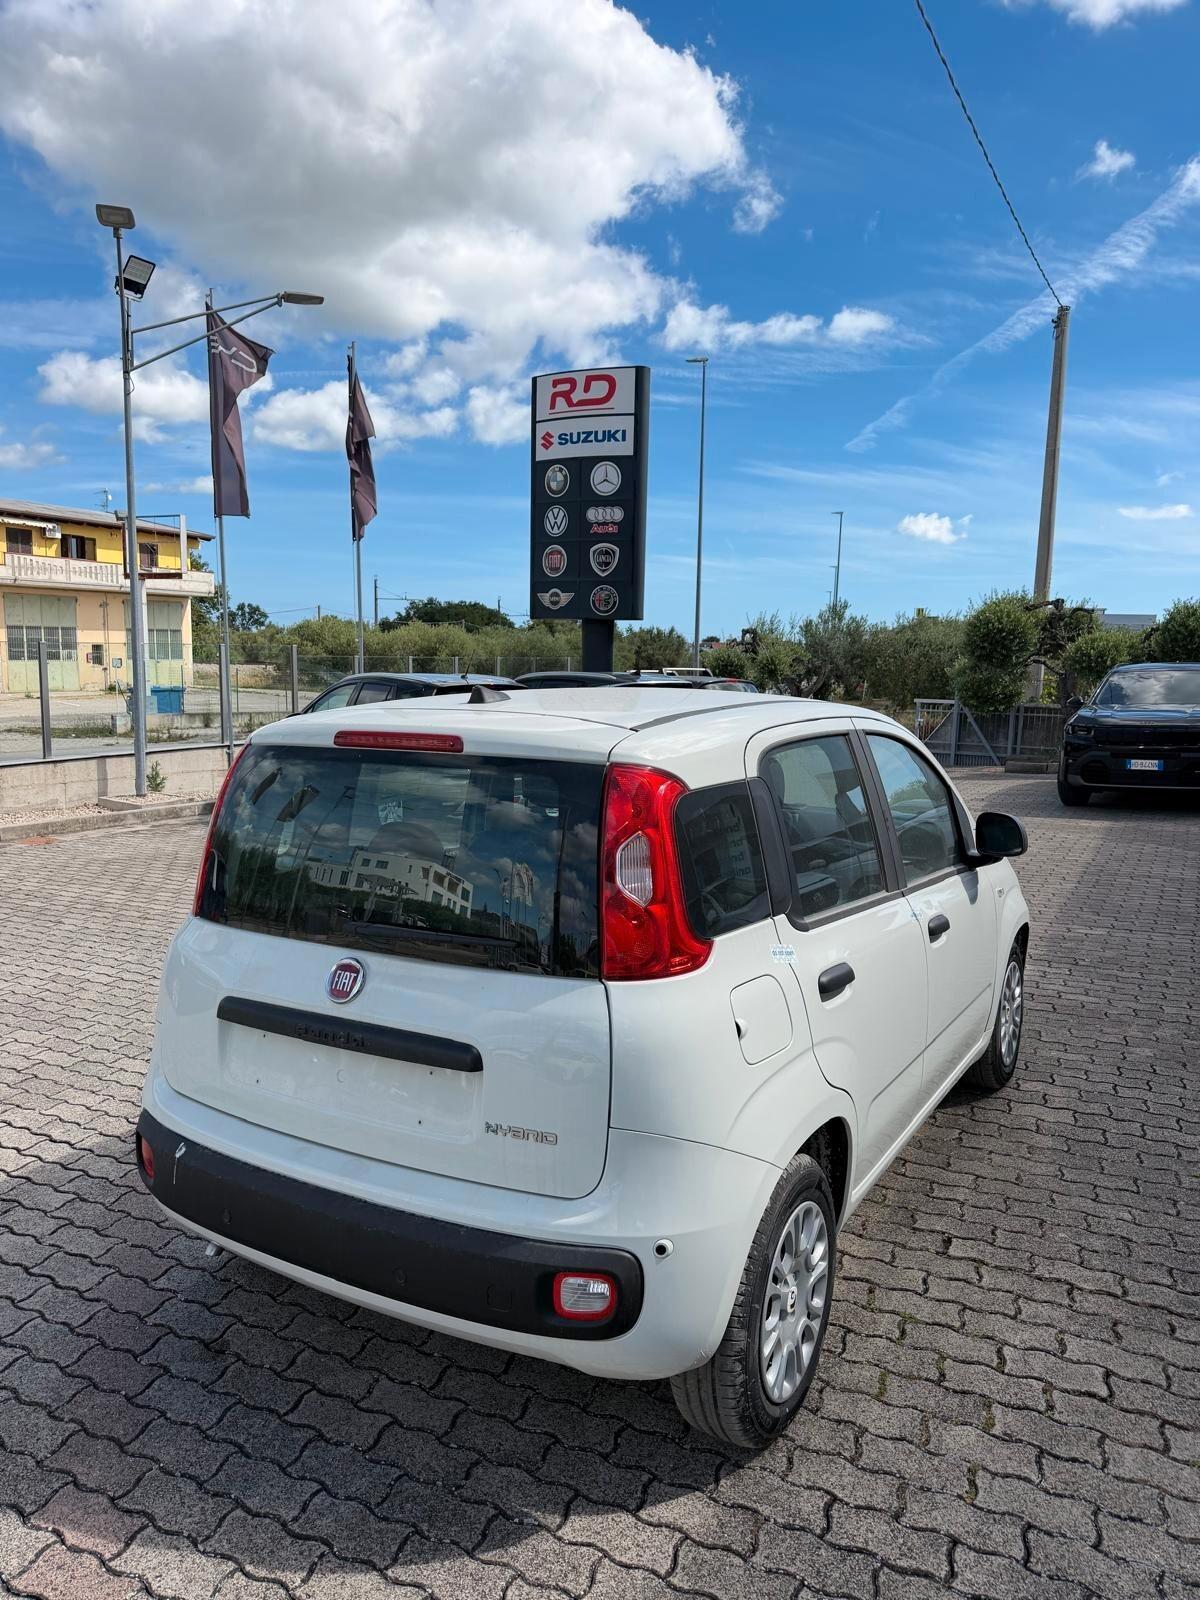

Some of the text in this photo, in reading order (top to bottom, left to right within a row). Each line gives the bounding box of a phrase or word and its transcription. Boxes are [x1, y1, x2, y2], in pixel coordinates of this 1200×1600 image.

[549, 374, 617, 411] RD
[557, 429, 626, 446] SUZUKI
[331, 970, 357, 992] FIAT
[484, 1121, 558, 1146] HYBRID
